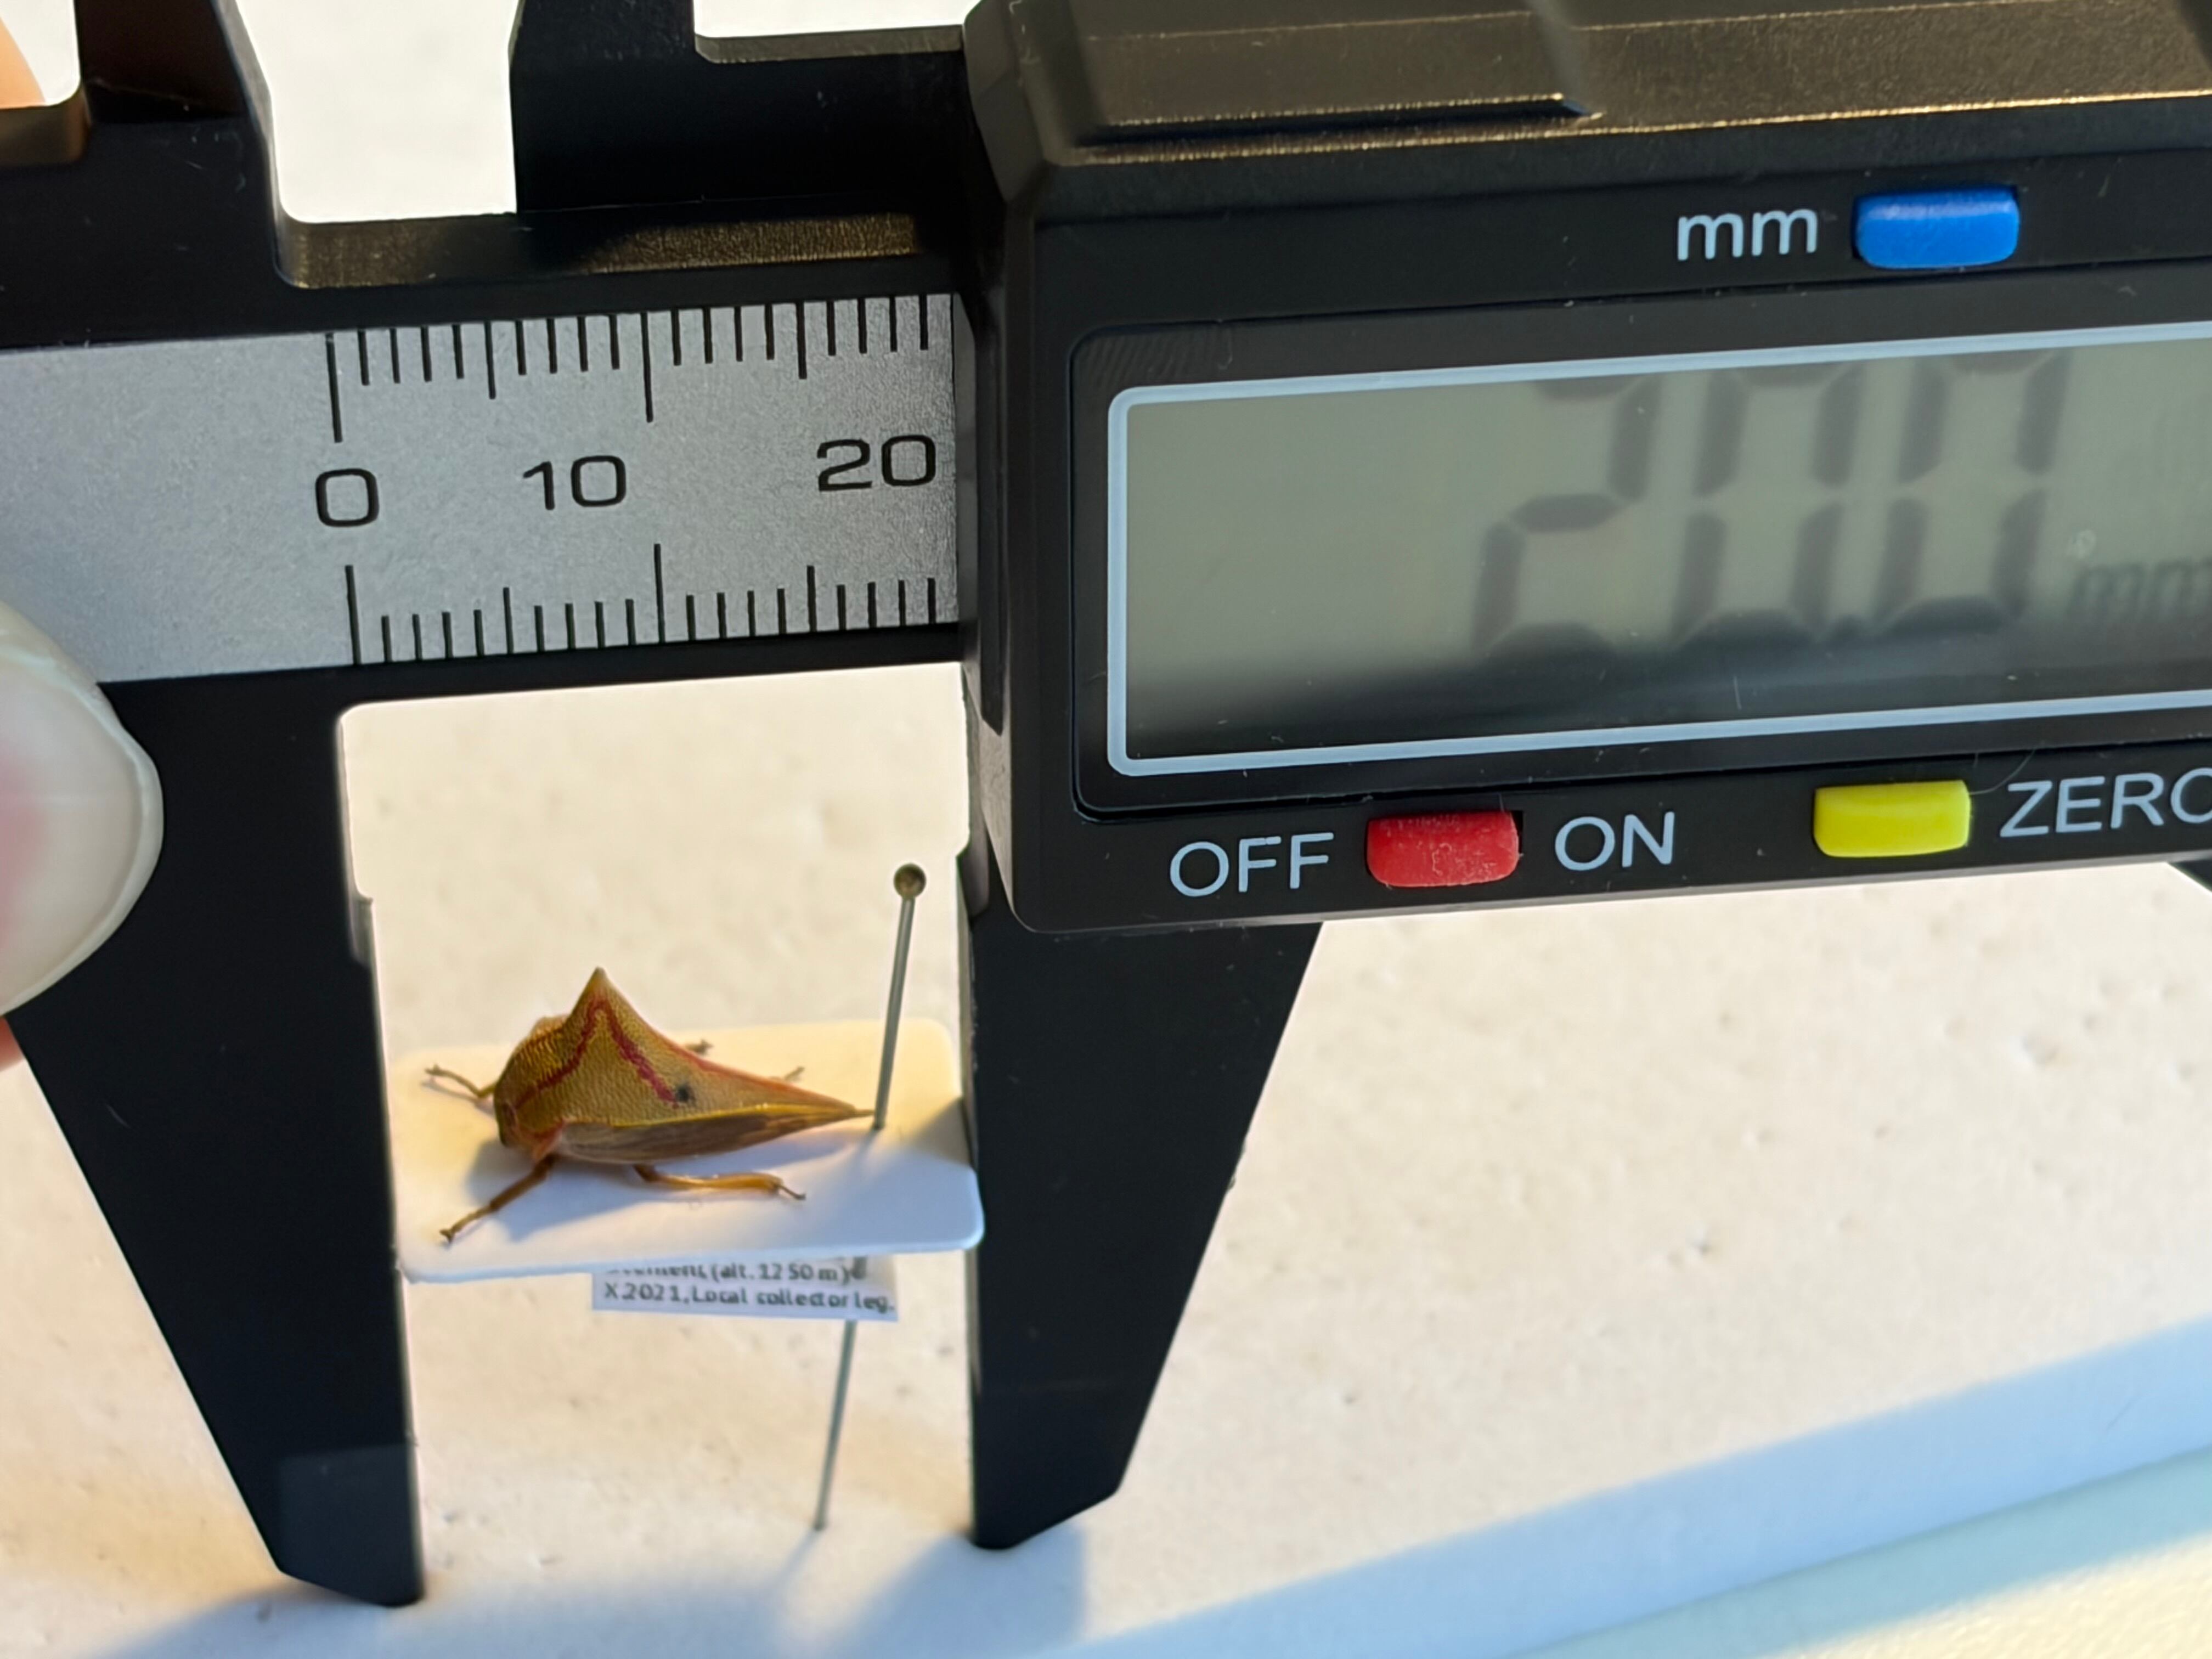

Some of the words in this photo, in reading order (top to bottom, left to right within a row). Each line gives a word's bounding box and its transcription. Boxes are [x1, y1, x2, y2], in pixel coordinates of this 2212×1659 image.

[1677, 208, 1819, 261] mm
[315, 468, 380, 528] 0
[522, 455, 627, 511] 10
[816, 435, 937, 492] 20
[1999, 767, 2212, 838] ZERO
[1169, 832, 1335, 898] OFF
[1554, 811, 1675, 871] ON
[692, 1285, 747, 1304] Local
[756, 1288, 849, 1308] collector
[759, 1262, 814, 1280] 1250
